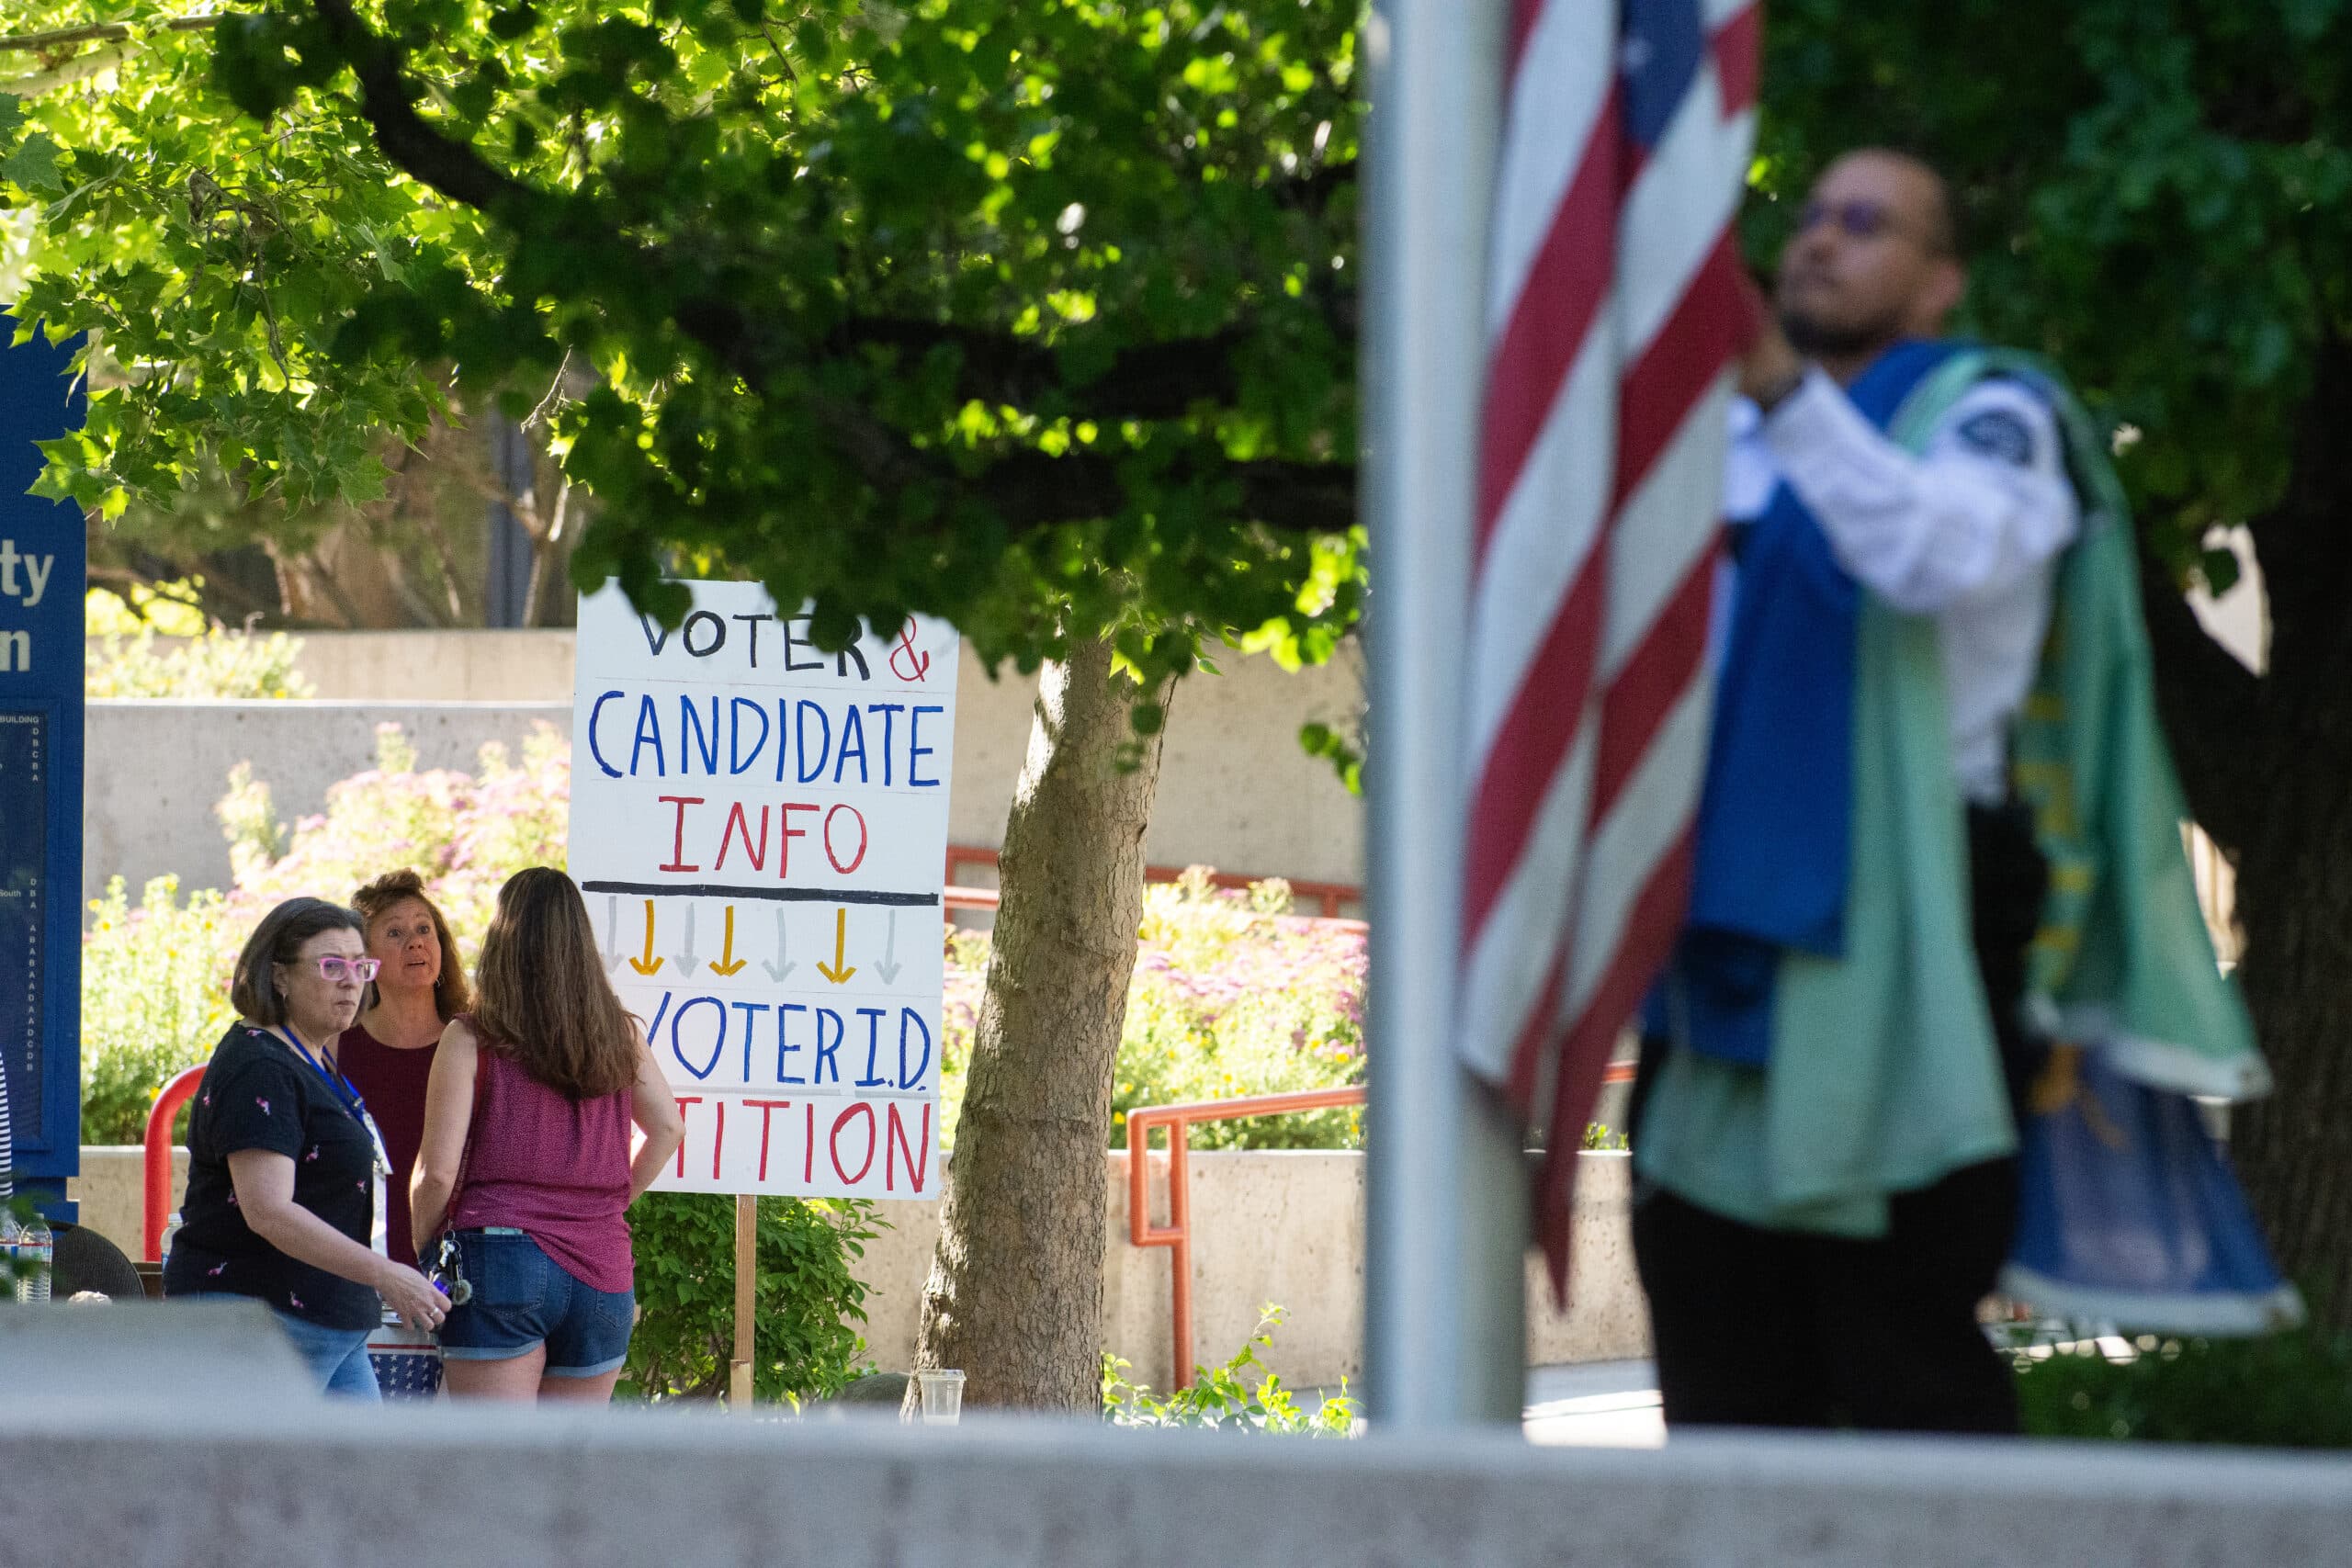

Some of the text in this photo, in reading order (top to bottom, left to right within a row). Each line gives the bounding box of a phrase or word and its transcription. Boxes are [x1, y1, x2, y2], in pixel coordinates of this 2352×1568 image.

[889, 613, 930, 682] &
[589, 691, 944, 787] CANDIDATE
[658, 795, 867, 879] INFO
[0, 889, 21, 897] South
